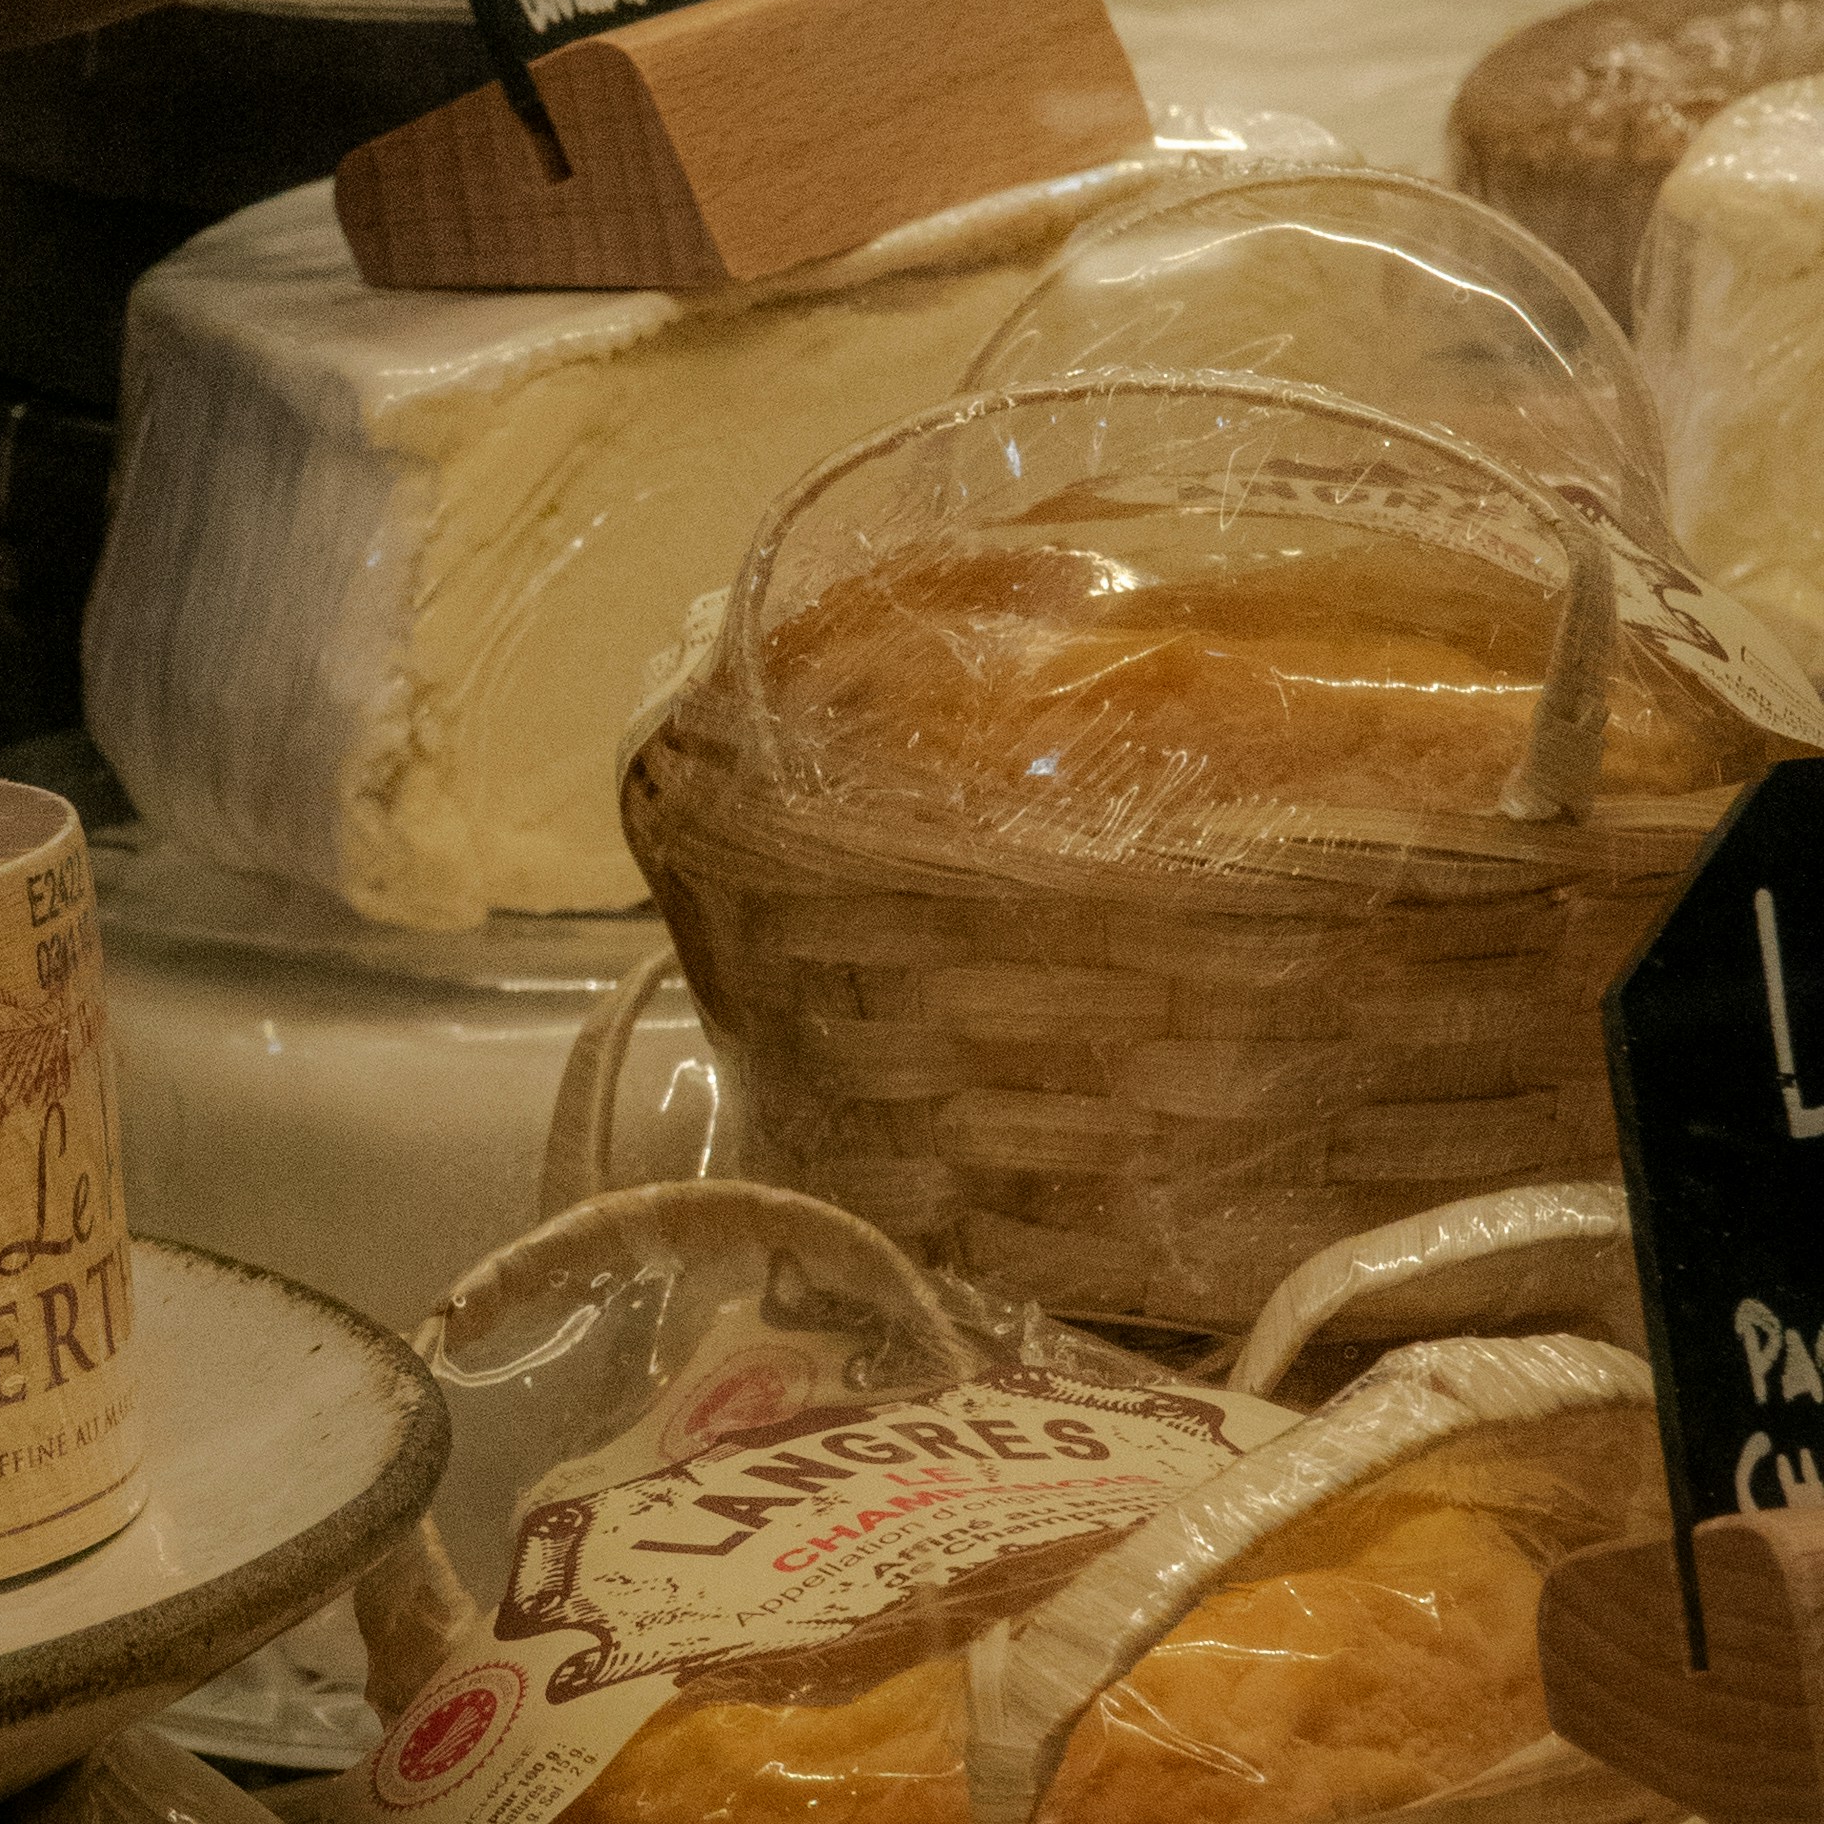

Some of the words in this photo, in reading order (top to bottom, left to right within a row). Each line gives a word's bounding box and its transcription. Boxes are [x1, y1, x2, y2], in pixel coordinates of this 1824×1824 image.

[1734, 1297, 1824, 1406] PA
[631, 1417, 1113, 1557] LANGRES
[883, 1465, 973, 1489] LE
[733, 1519, 928, 1629] Appellation
[487, 1789, 519, 1824] pour
